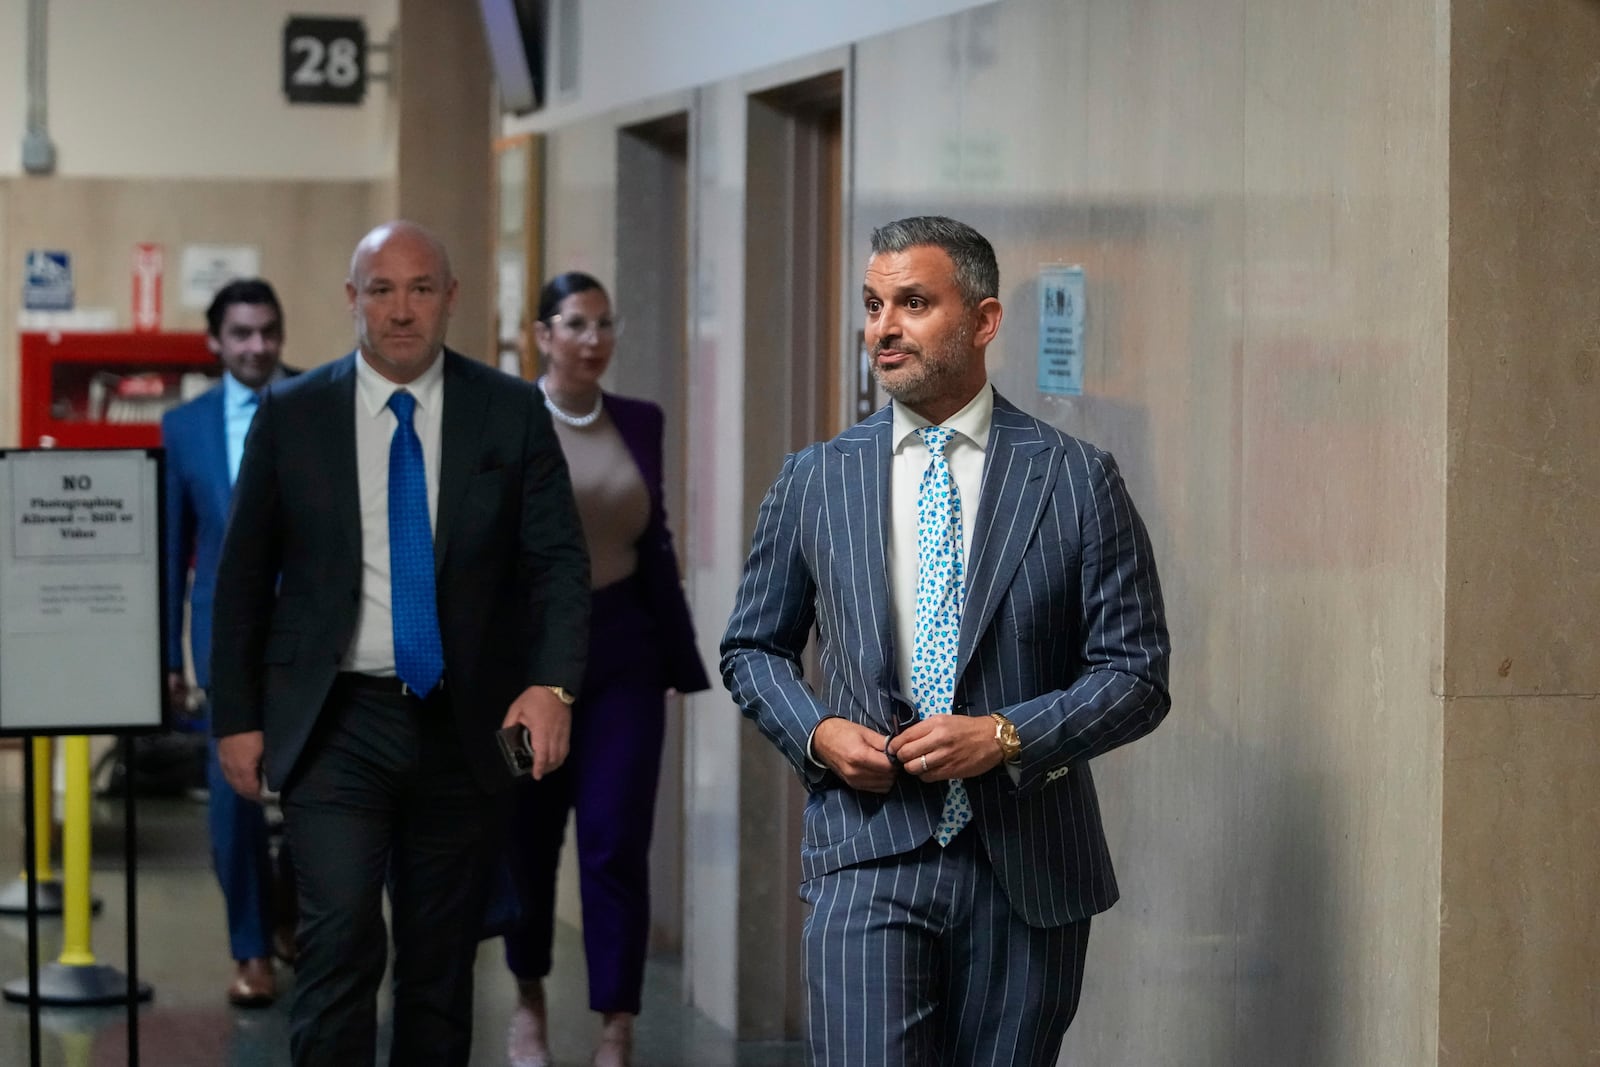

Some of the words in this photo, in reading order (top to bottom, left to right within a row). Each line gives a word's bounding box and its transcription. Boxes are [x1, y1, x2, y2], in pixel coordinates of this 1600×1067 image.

[290, 36, 360, 87] 28
[62, 475, 92, 491] NO
[30, 498, 124, 510] Photographing
[22, 513, 74, 524] Allowed
[91, 512, 117, 523] Still
[120, 514, 133, 522] or
[60, 528, 97, 539] Video
